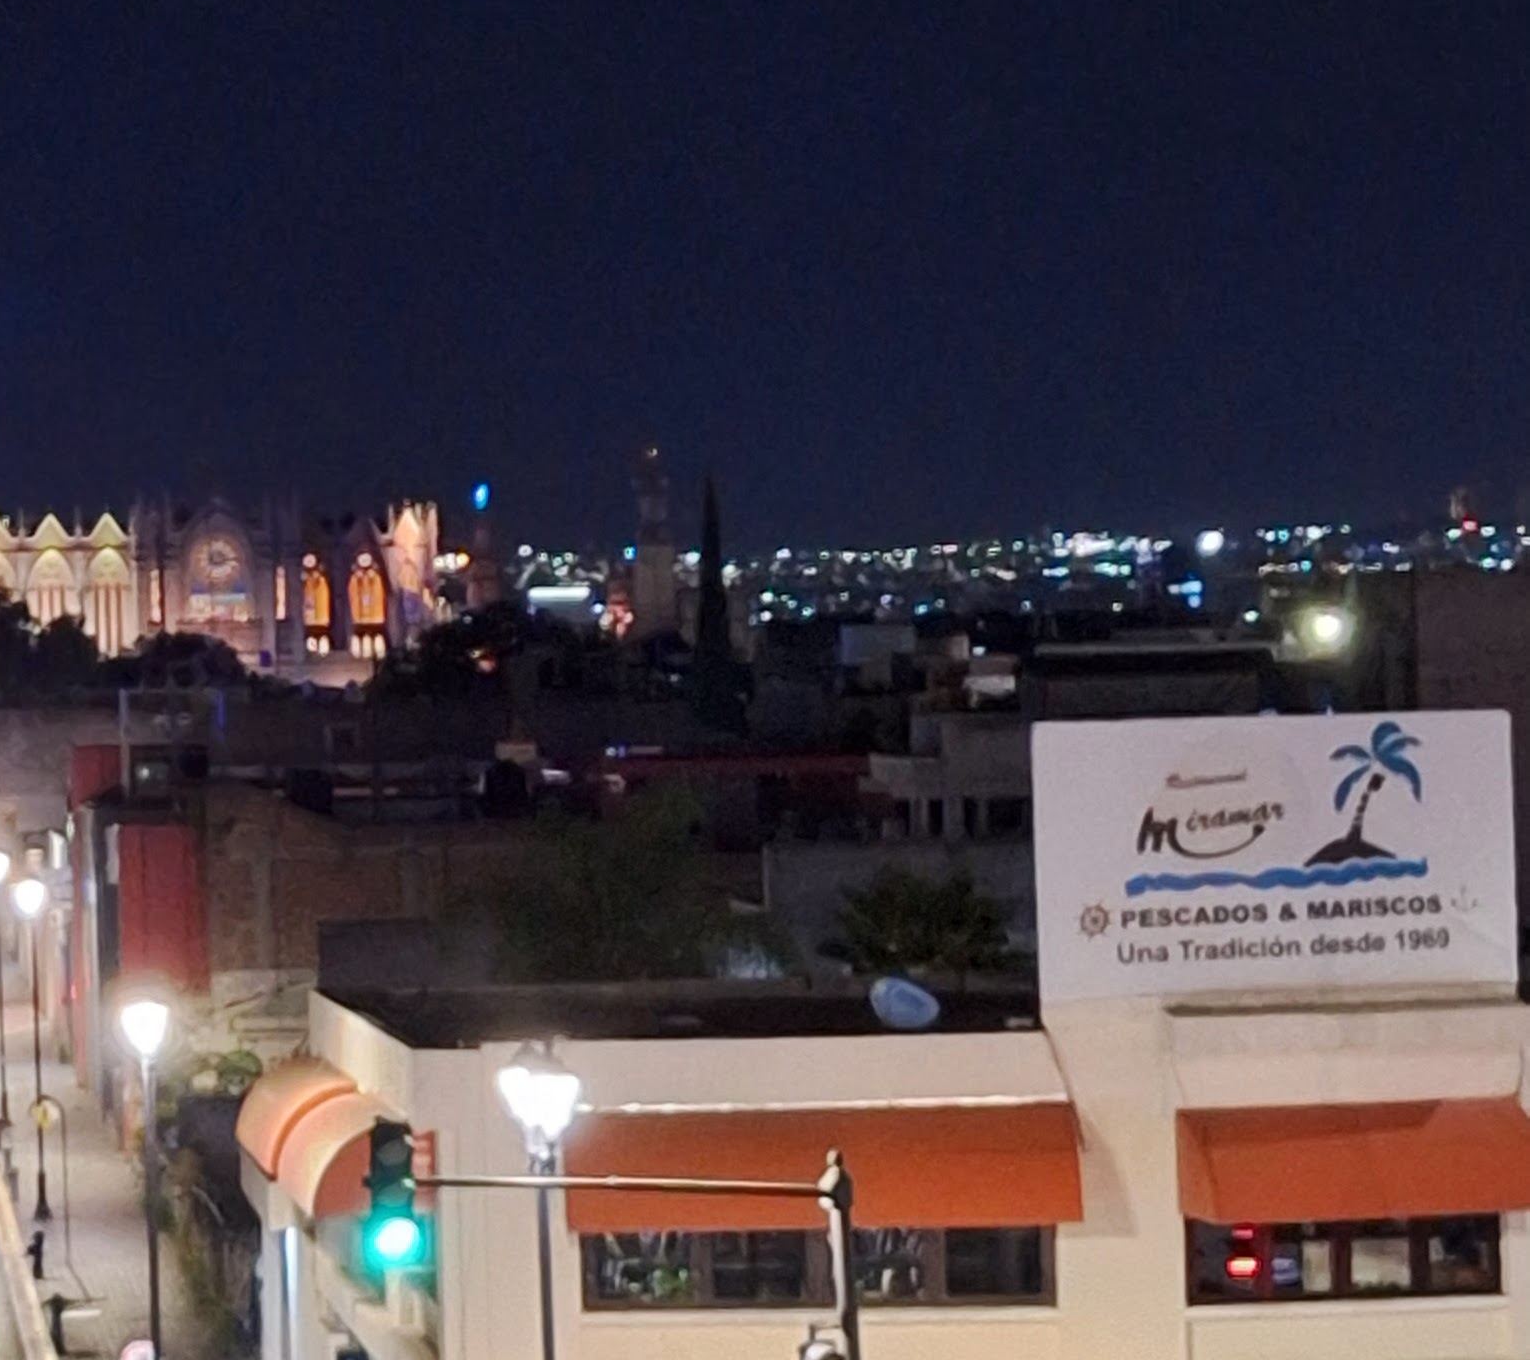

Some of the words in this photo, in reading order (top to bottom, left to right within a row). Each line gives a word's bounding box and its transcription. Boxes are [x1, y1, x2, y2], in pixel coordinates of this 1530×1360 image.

[1120, 903, 1268, 929] PESCADOS
[1278, 901, 1298, 922] &
[1306, 894, 1443, 920] MARISCOS
[1117, 941, 1169, 965] Una
[1178, 936, 1302, 961] Tradición
[1310, 933, 1386, 956] desde
